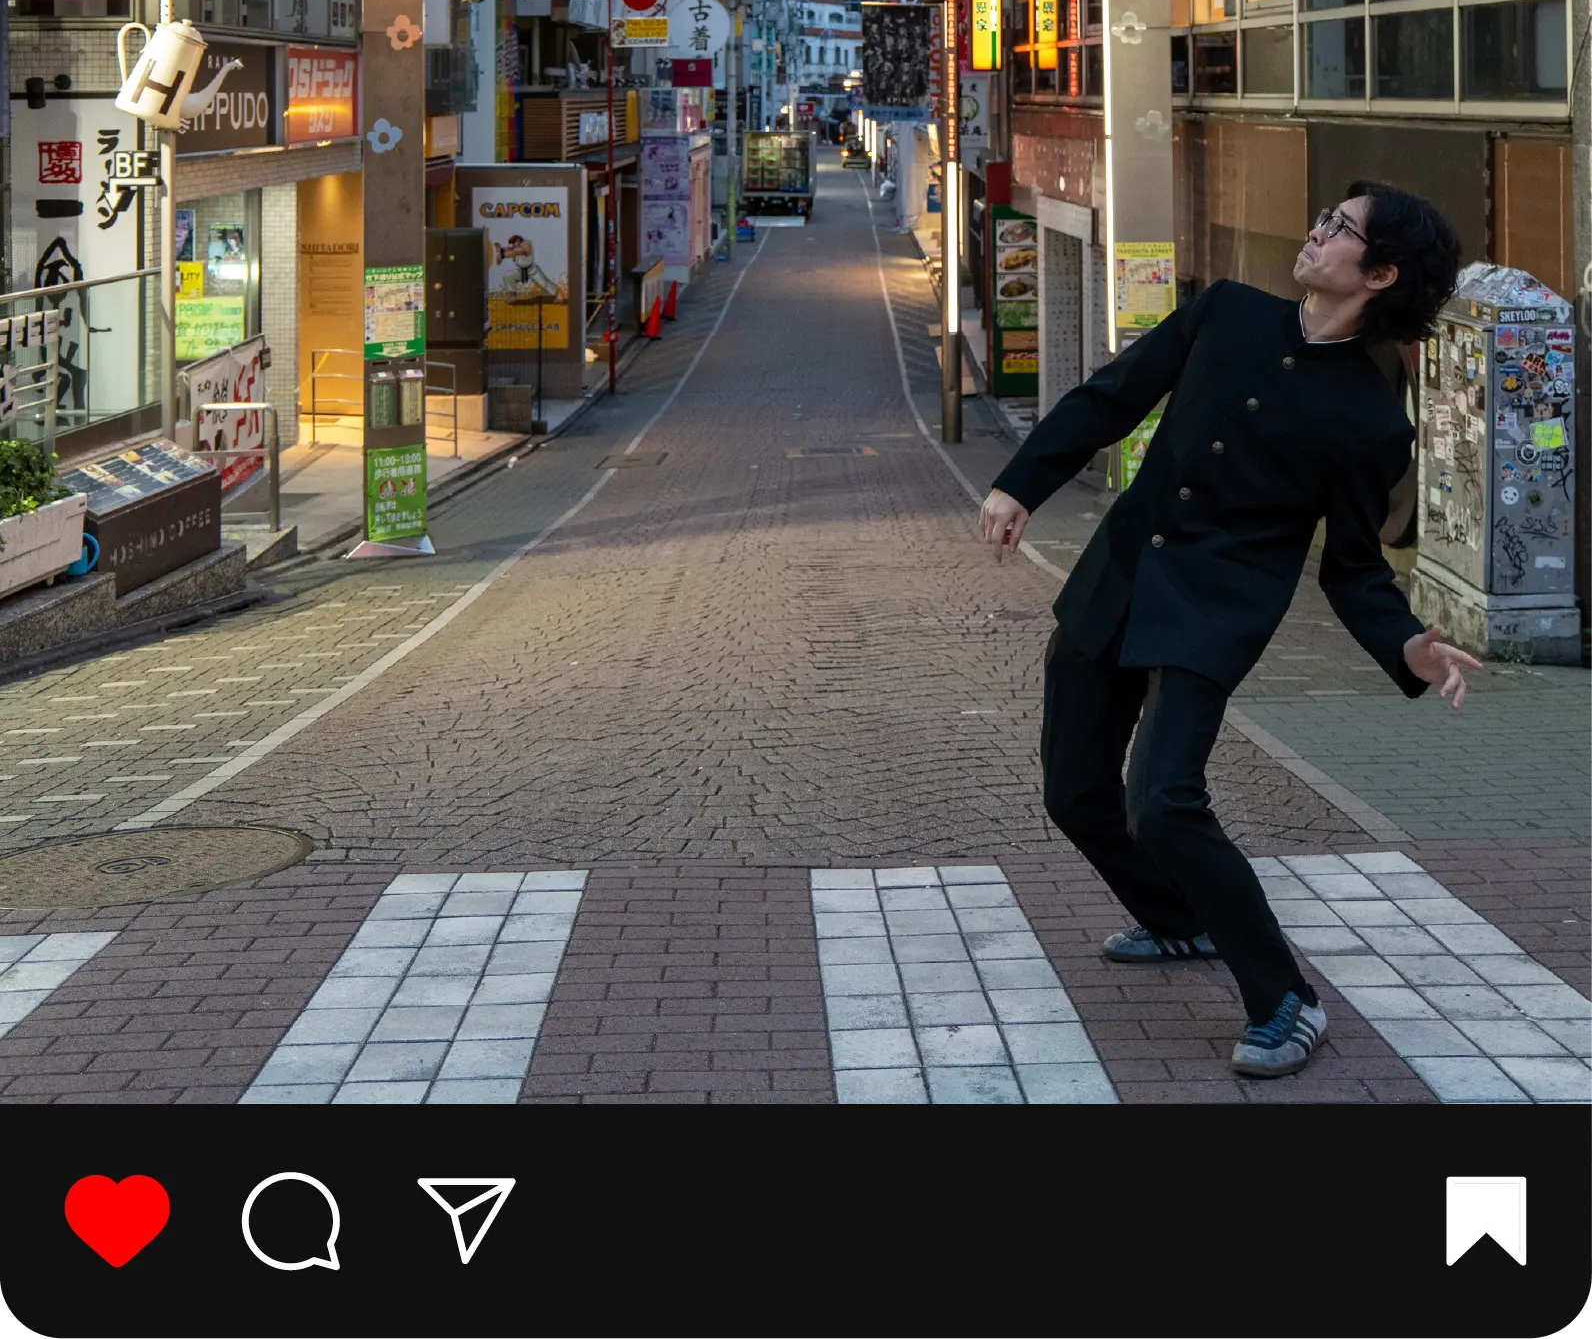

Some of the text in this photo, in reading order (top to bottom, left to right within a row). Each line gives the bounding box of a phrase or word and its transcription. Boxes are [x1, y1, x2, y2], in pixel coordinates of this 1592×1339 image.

[130, 58, 186, 116] H
[193, 91, 270, 131] PPUDO
[38, 141, 82, 183] 博多
[115, 152, 148, 178] BF
[479, 202, 560, 218] CAPCOM
[1500, 310, 1536, 323] SKEYLOO
[109, 527, 165, 567] HOSHINO
